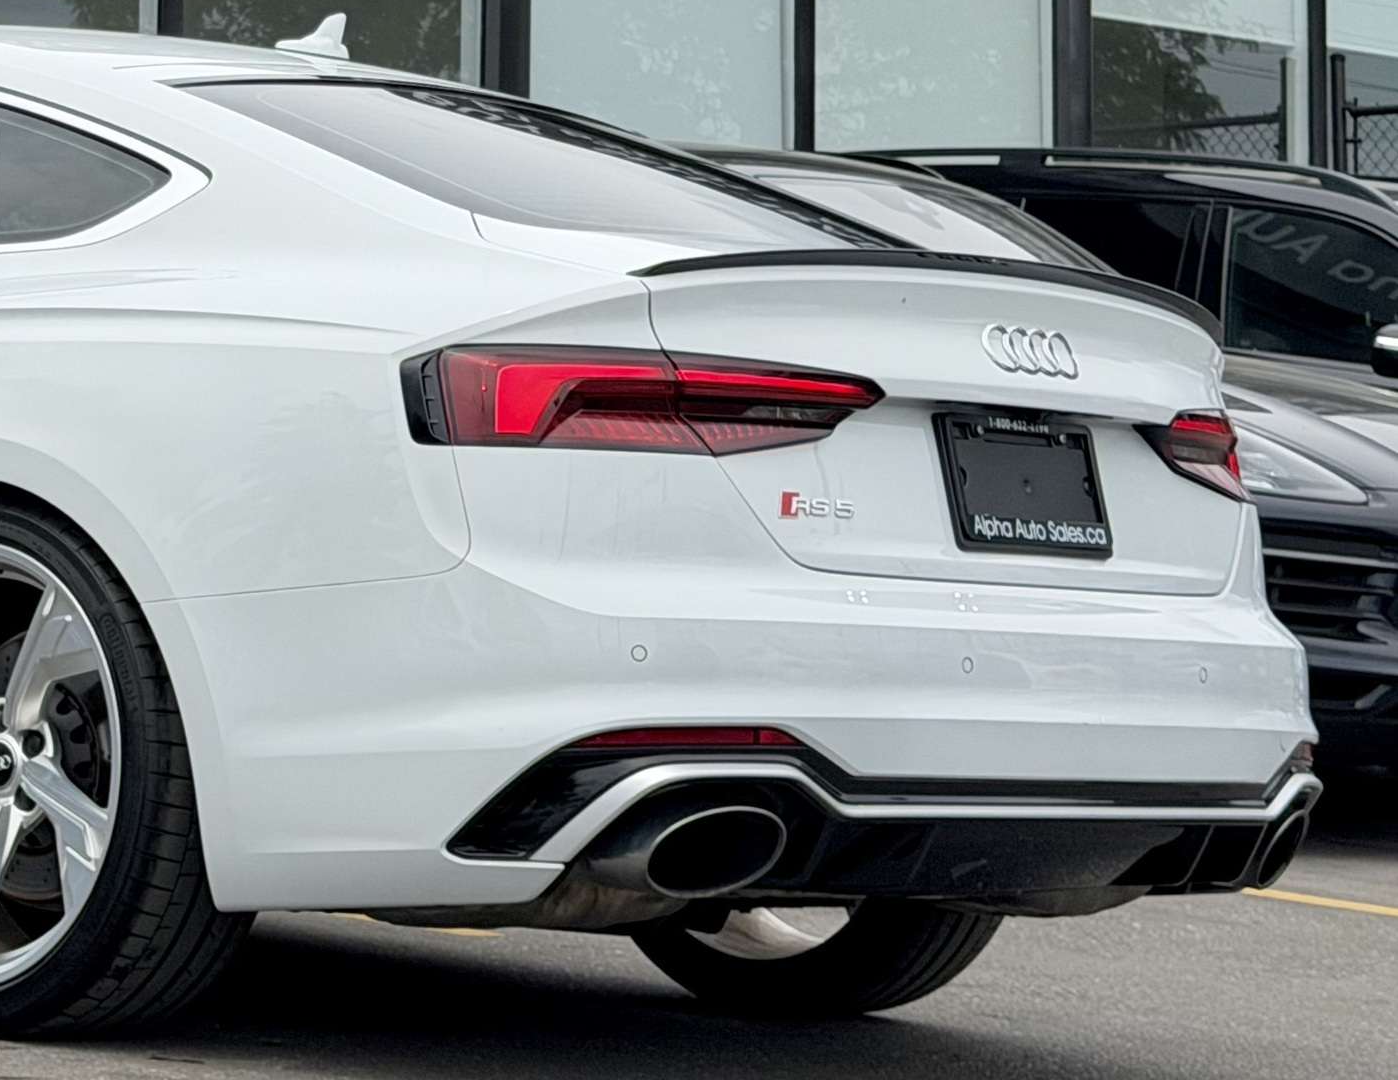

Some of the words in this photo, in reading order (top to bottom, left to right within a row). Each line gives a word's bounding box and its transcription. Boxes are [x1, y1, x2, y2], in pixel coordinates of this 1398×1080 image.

[974, 514, 1014, 540] Alpha
[1015, 517, 1046, 541] Auto
[1047, 520, 1108, 545] Sales.ca
